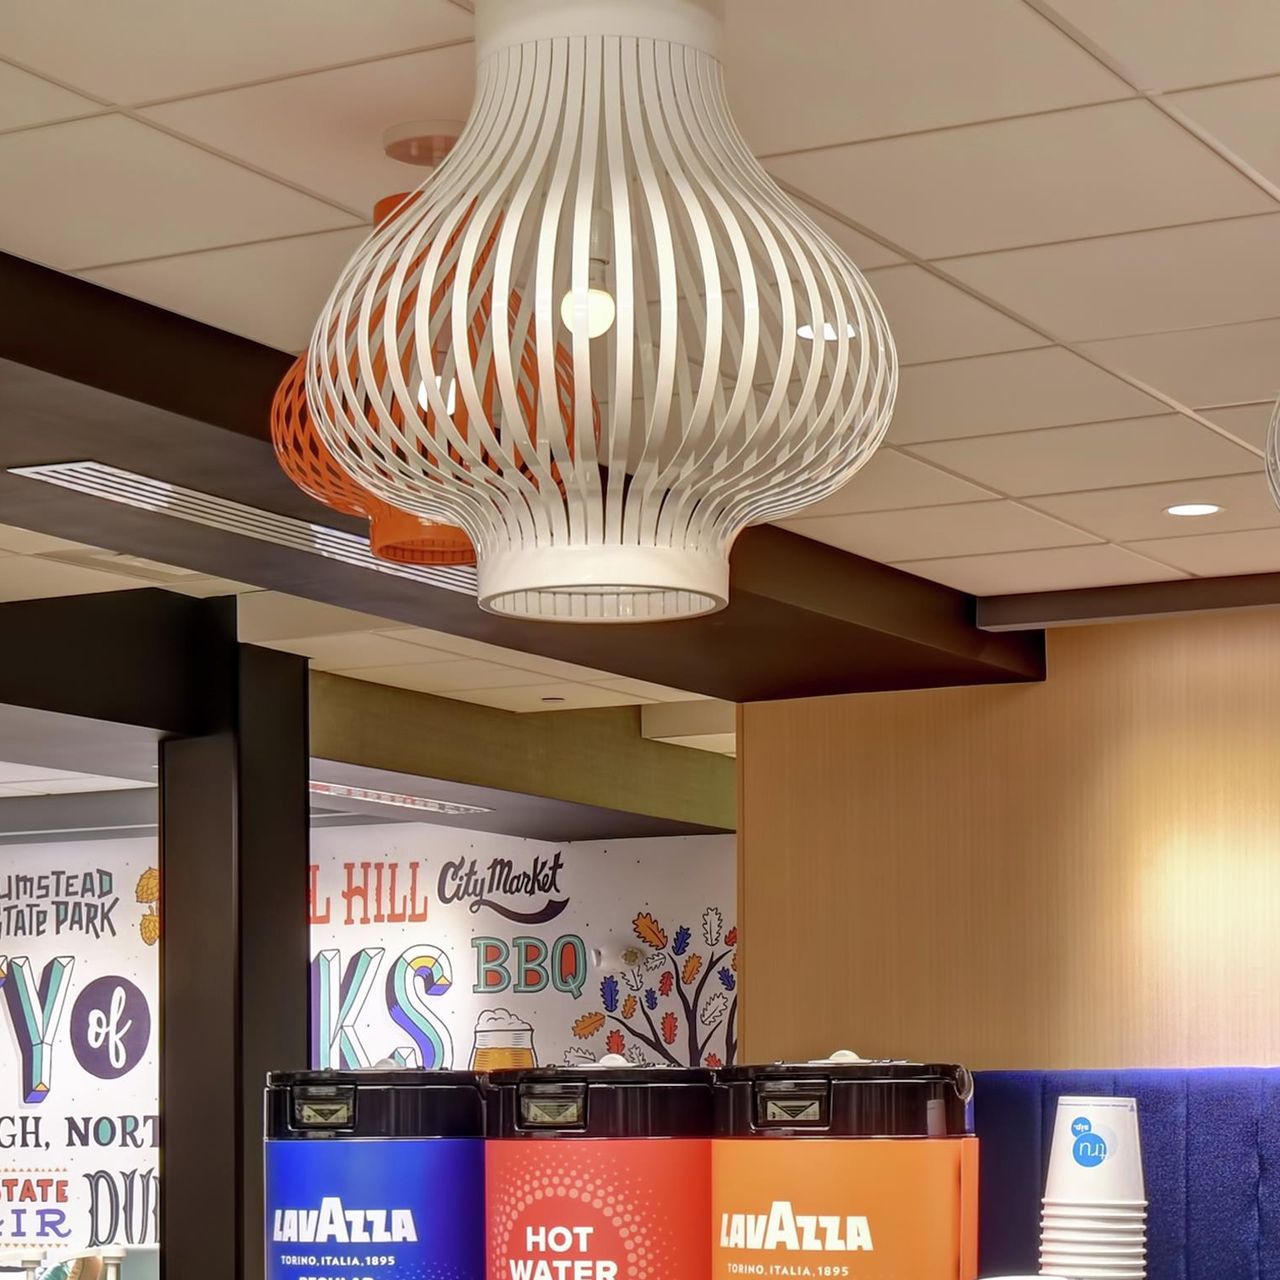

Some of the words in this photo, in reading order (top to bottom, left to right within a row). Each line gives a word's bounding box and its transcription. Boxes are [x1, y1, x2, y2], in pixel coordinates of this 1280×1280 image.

[341, 862, 428, 925] HILL
[437, 856, 486, 913] City
[487, 851, 564, 896] Market
[51, 896, 120, 939] PARK
[471, 934, 587, 1000] BBQ
[87, 986, 132, 1069] of
[82, 1168, 159, 1249] DU
[273, 1197, 418, 1243] LAVAZZA
[526, 1226, 594, 1252] HOT
[720, 1200, 874, 1251] LAVAZZA
